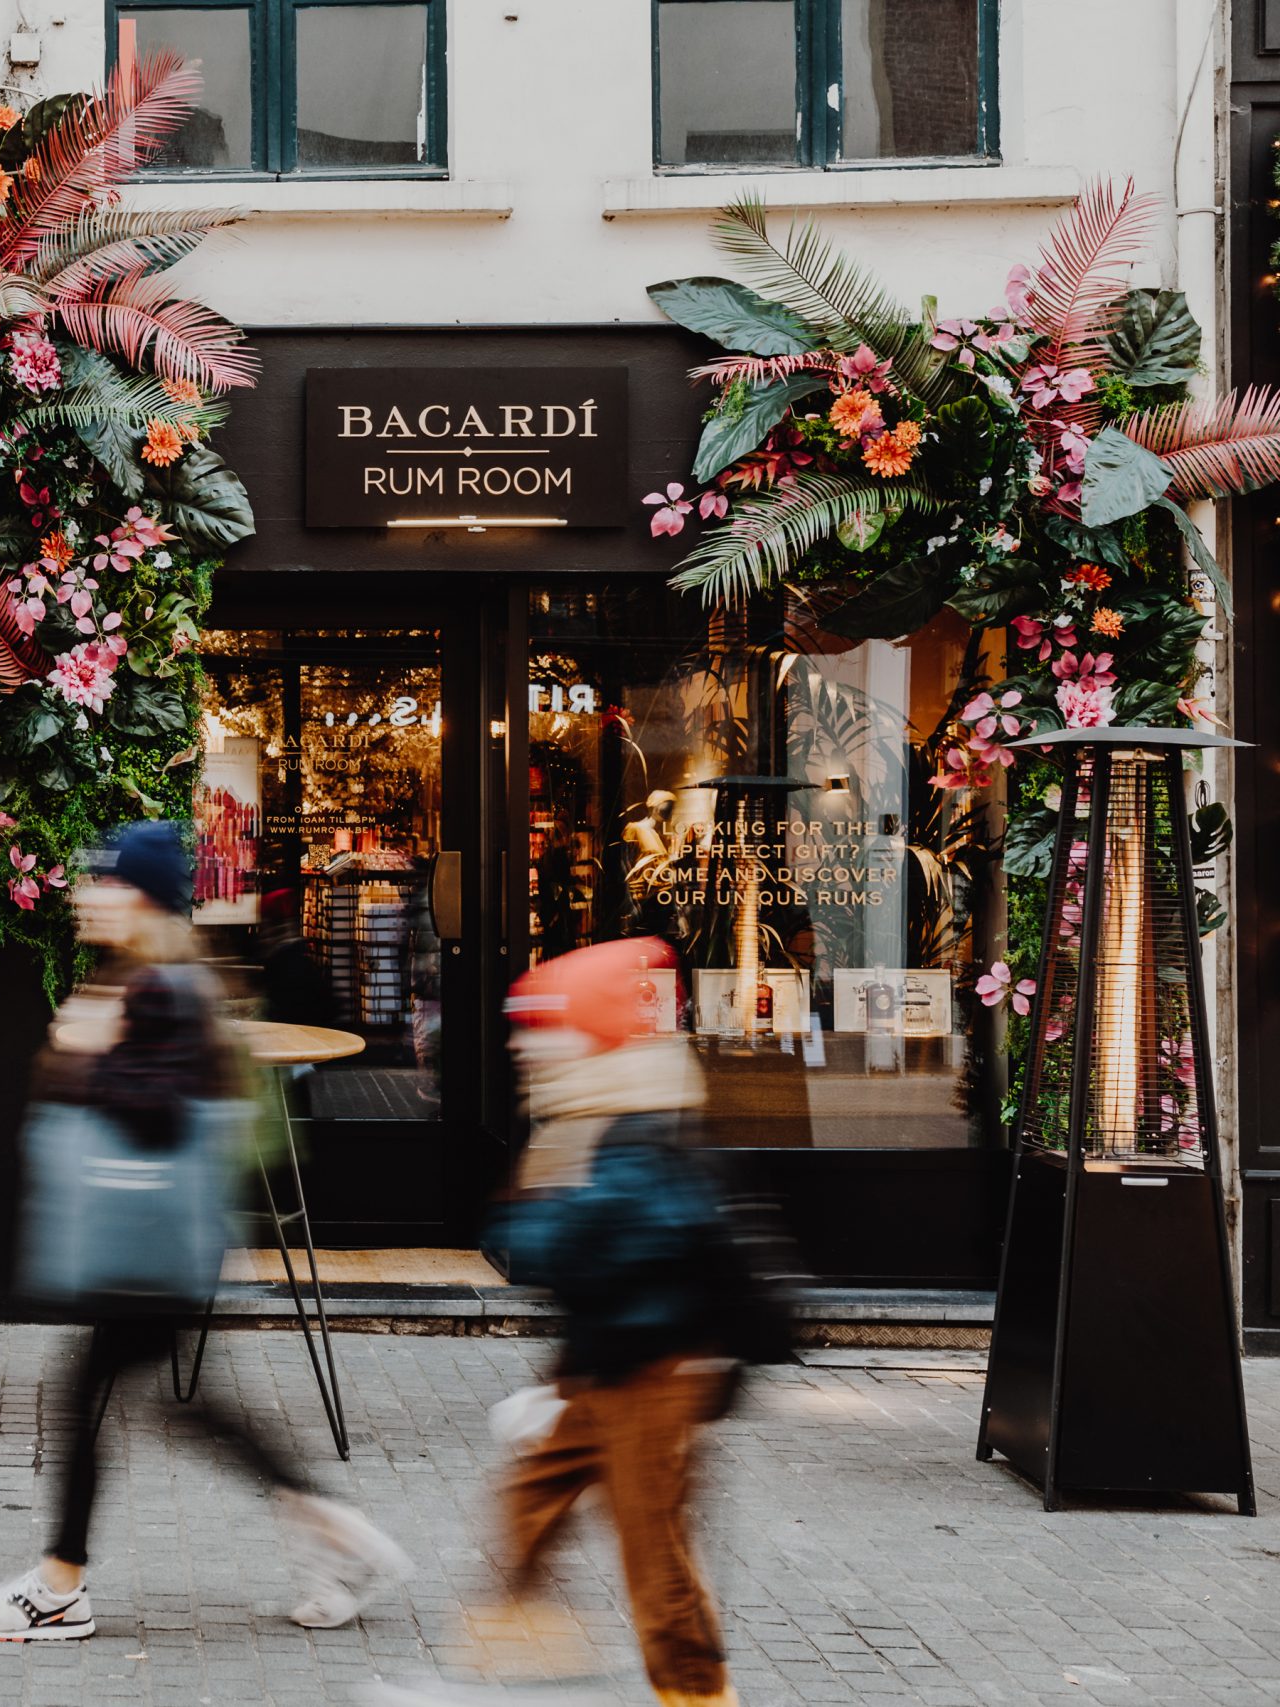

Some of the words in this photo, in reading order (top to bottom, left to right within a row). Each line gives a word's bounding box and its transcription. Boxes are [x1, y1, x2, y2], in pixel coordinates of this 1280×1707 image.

[337, 398, 599, 438] BACARDÍ
[364, 467, 444, 495] RUM
[458, 467, 572, 495] ROOM
[315, 758, 361, 770] ROOM
[661, 821, 766, 836] LOOKING
[776, 821, 823, 836] FOR
[833, 821, 878, 836] THE
[679, 844, 785, 859] PERFECT
[795, 844, 860, 859] GIFT?
[643, 867, 709, 882] COME
[719, 867, 768, 882] AND
[778, 867, 897, 882] DISCOVER
[657, 890, 705, 905] OUR
[716, 890, 807, 905] UNQUE
[818, 890, 883, 905] RUMS
